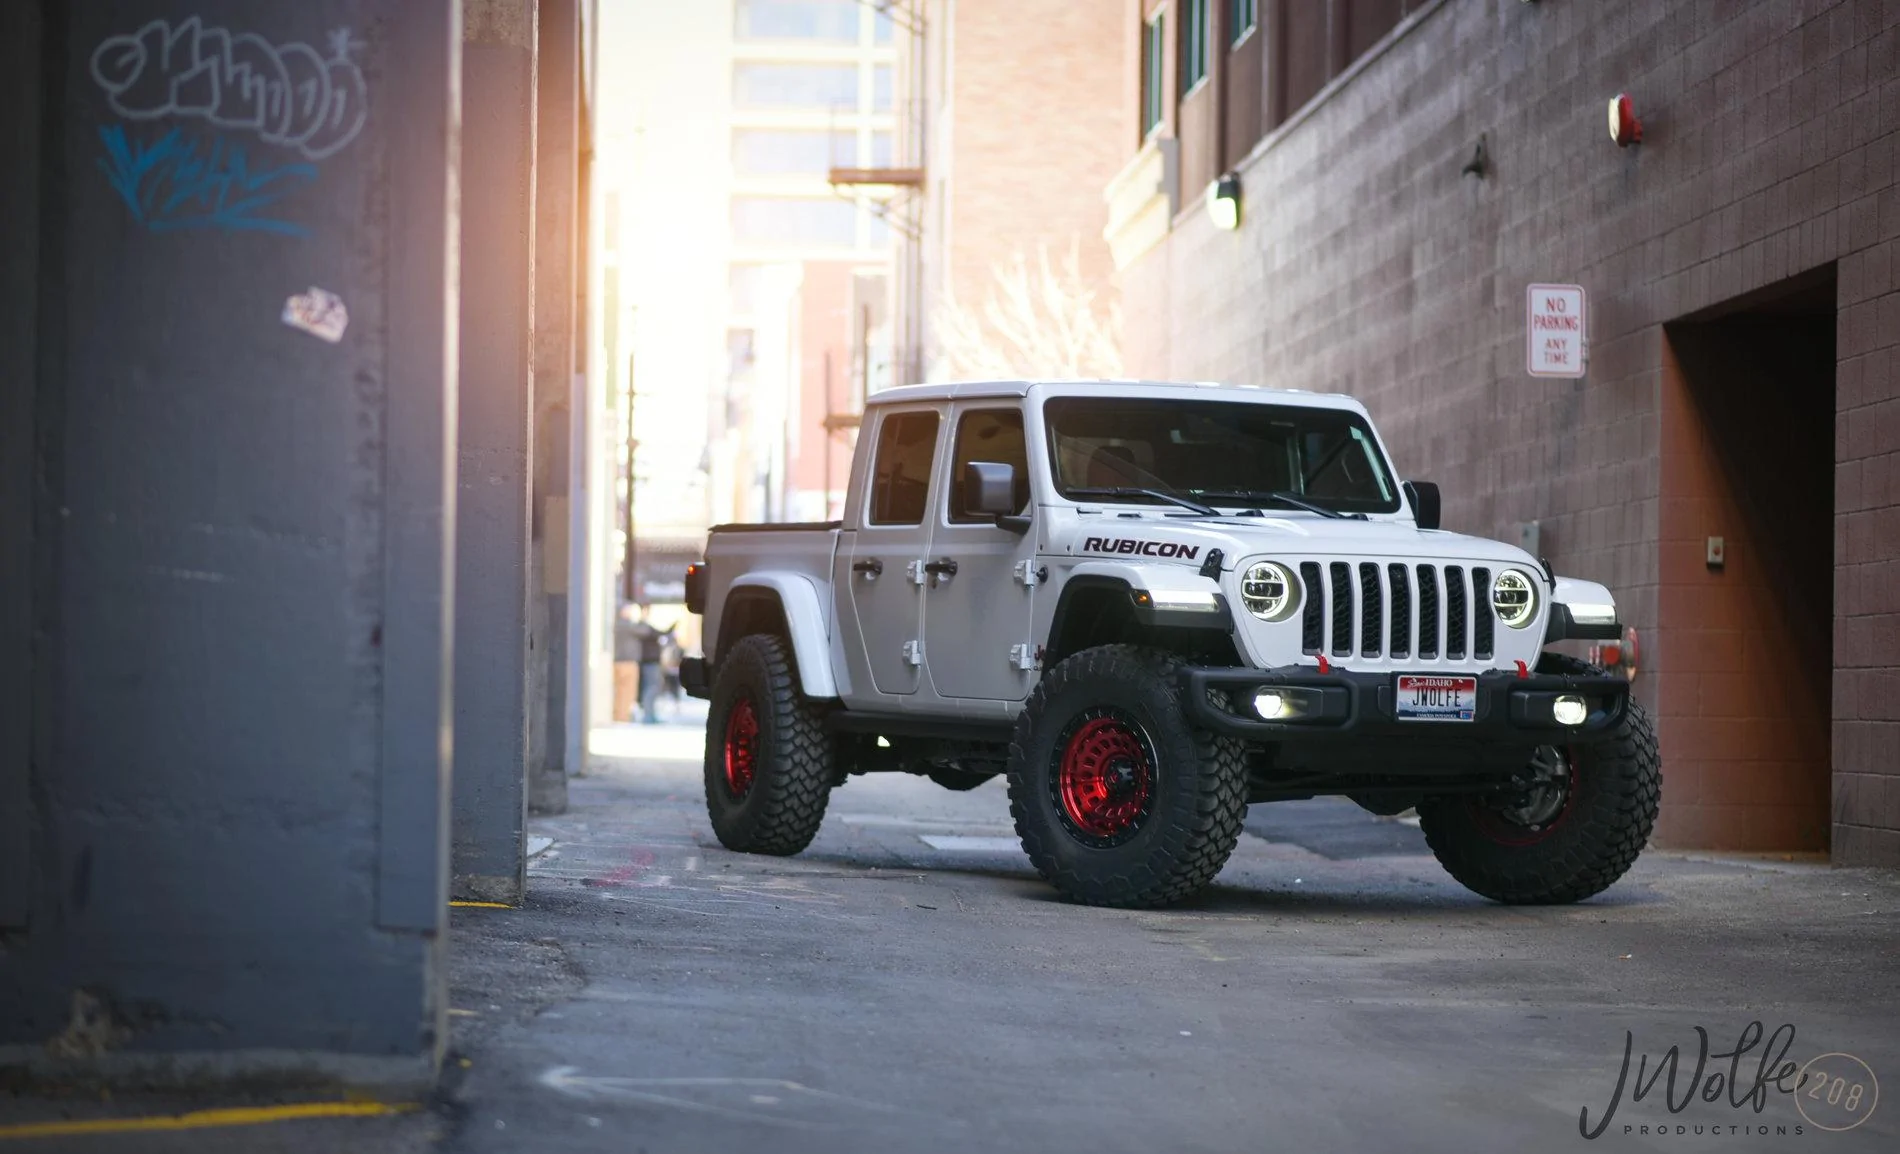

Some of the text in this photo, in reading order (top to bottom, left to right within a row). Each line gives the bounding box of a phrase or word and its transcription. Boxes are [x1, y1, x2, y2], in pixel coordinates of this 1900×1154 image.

[1546, 297, 1566, 313] NO
[1534, 314, 1578, 330] PARKING
[1545, 338, 1567, 350] ANY
[1544, 352, 1568, 364] TIME
[1083, 537, 1200, 560] RUBICON
[1425, 678, 1453, 687] IDAHO
[1412, 688, 1462, 707] JWOLFE
